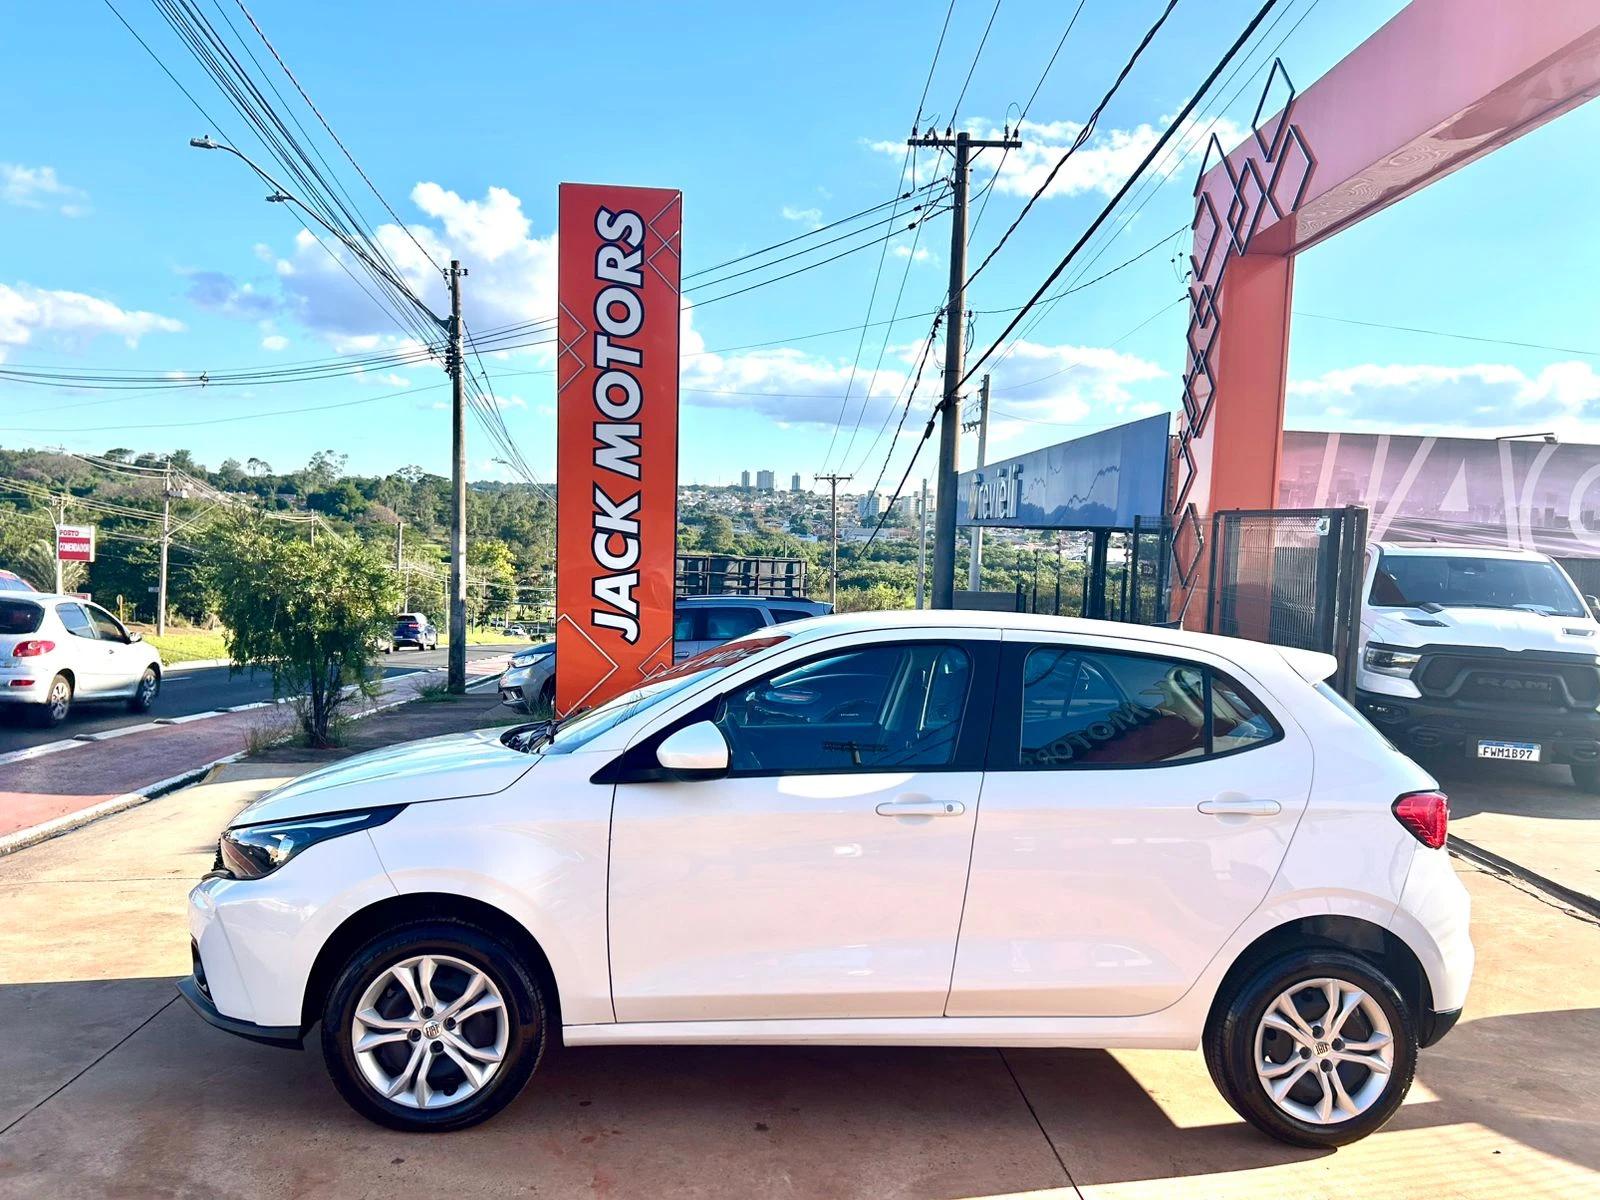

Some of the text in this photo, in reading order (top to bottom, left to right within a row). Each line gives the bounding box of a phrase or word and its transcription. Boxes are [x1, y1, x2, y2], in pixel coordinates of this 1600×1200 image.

[592, 206, 646, 645] JACK MOTORS
[59, 529, 80, 537] POSTO
[1482, 746, 1533, 760] FWM1B97
